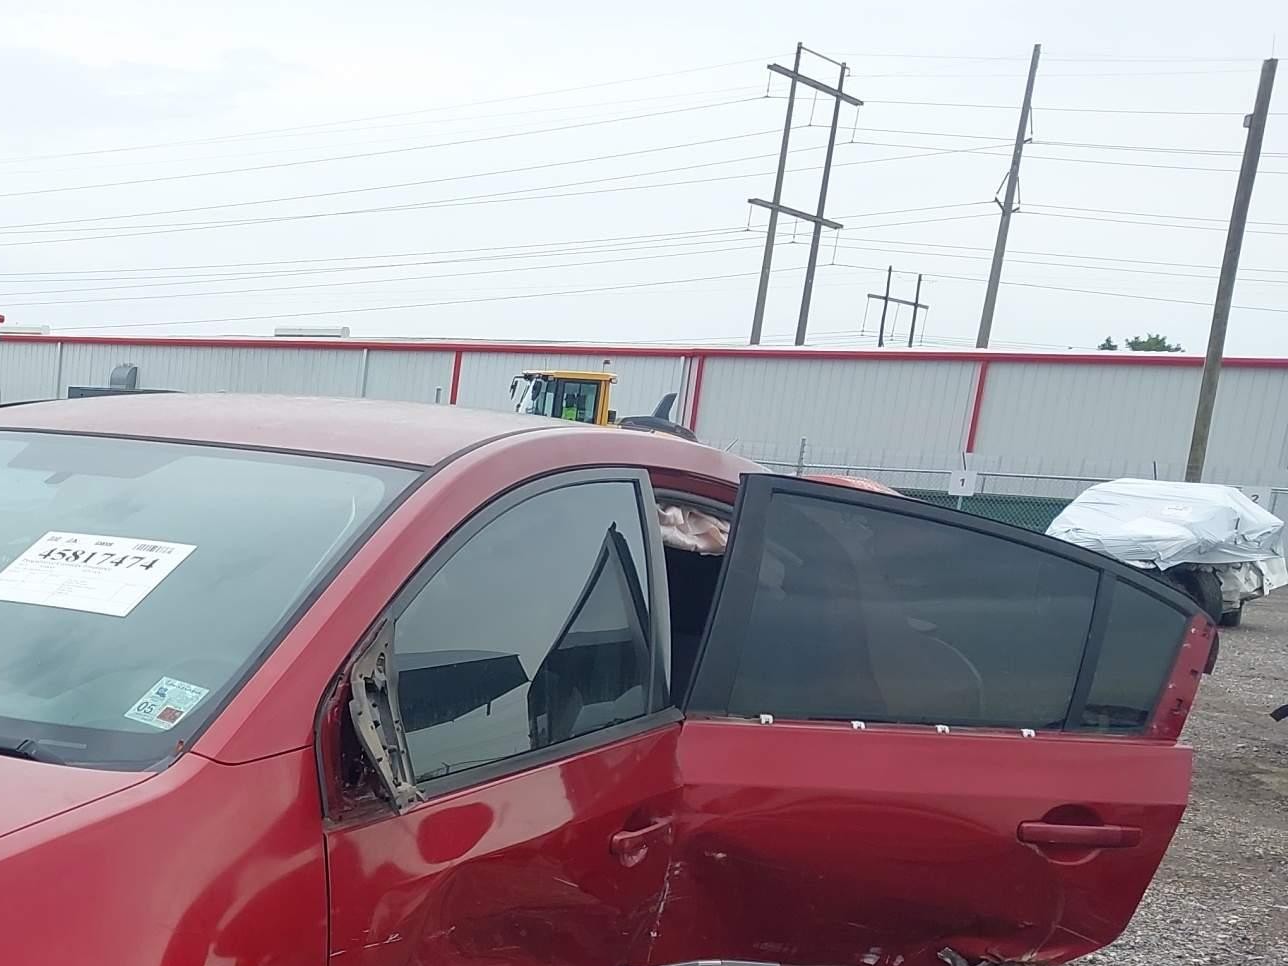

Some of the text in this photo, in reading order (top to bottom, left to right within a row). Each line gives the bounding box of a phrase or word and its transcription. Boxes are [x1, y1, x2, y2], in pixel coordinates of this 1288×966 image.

[959, 478, 966, 487] 1
[1251, 494, 1260, 504] 2
[38, 547, 161, 571] 45817474
[137, 701, 156, 714] 05
